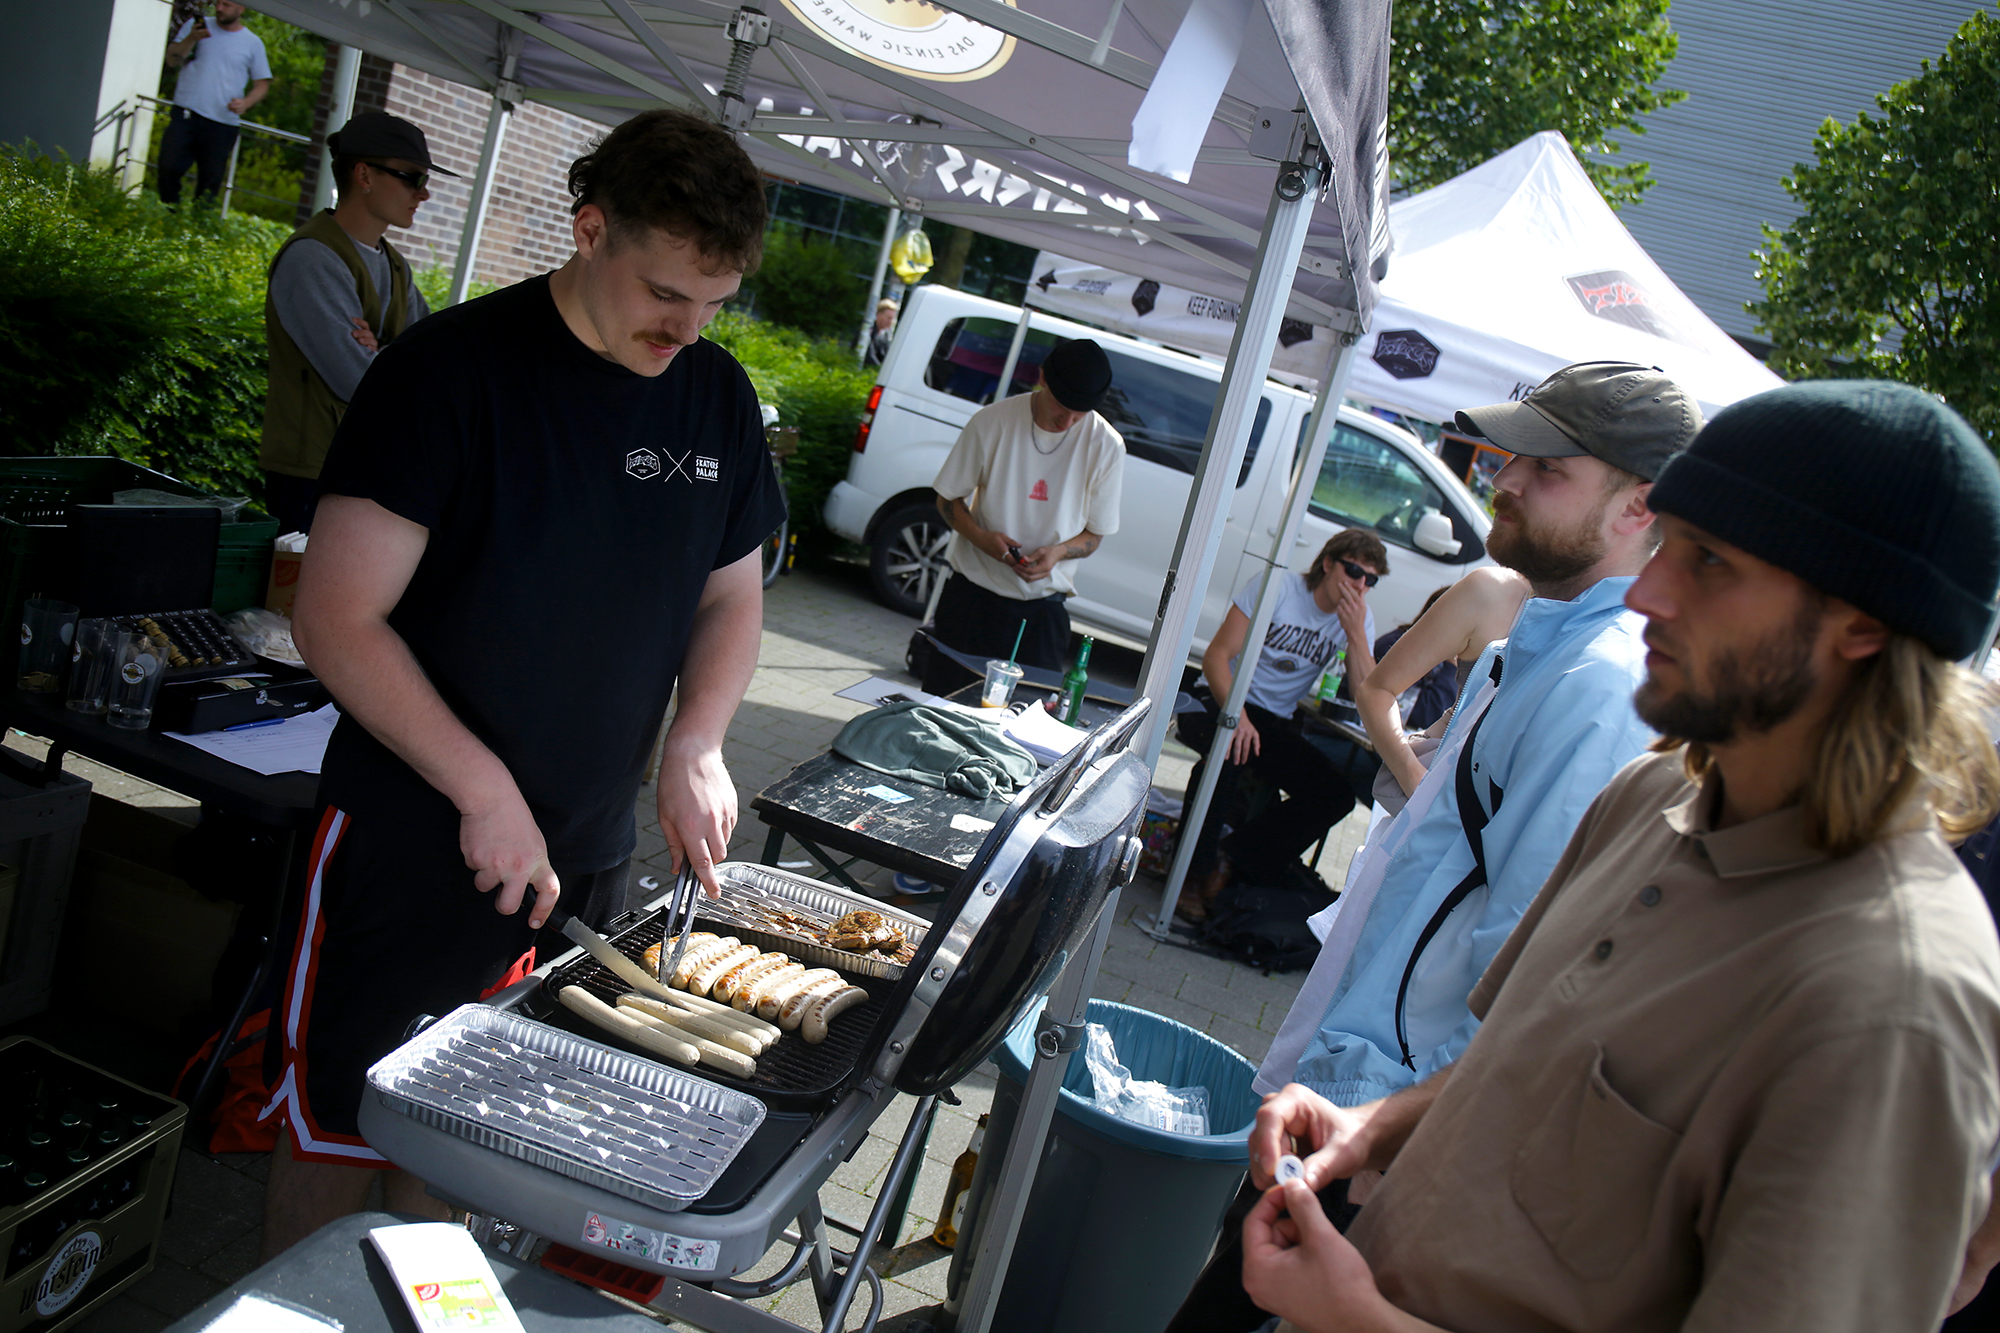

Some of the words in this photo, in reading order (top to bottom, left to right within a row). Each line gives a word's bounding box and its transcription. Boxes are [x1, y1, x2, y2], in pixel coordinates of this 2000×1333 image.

[1187, 295, 1208, 317] KEEP
[695, 458, 719, 470] SKATERS
[695, 467, 718, 479] PALACE
[19, 1234, 119, 1314] Warsteiner
